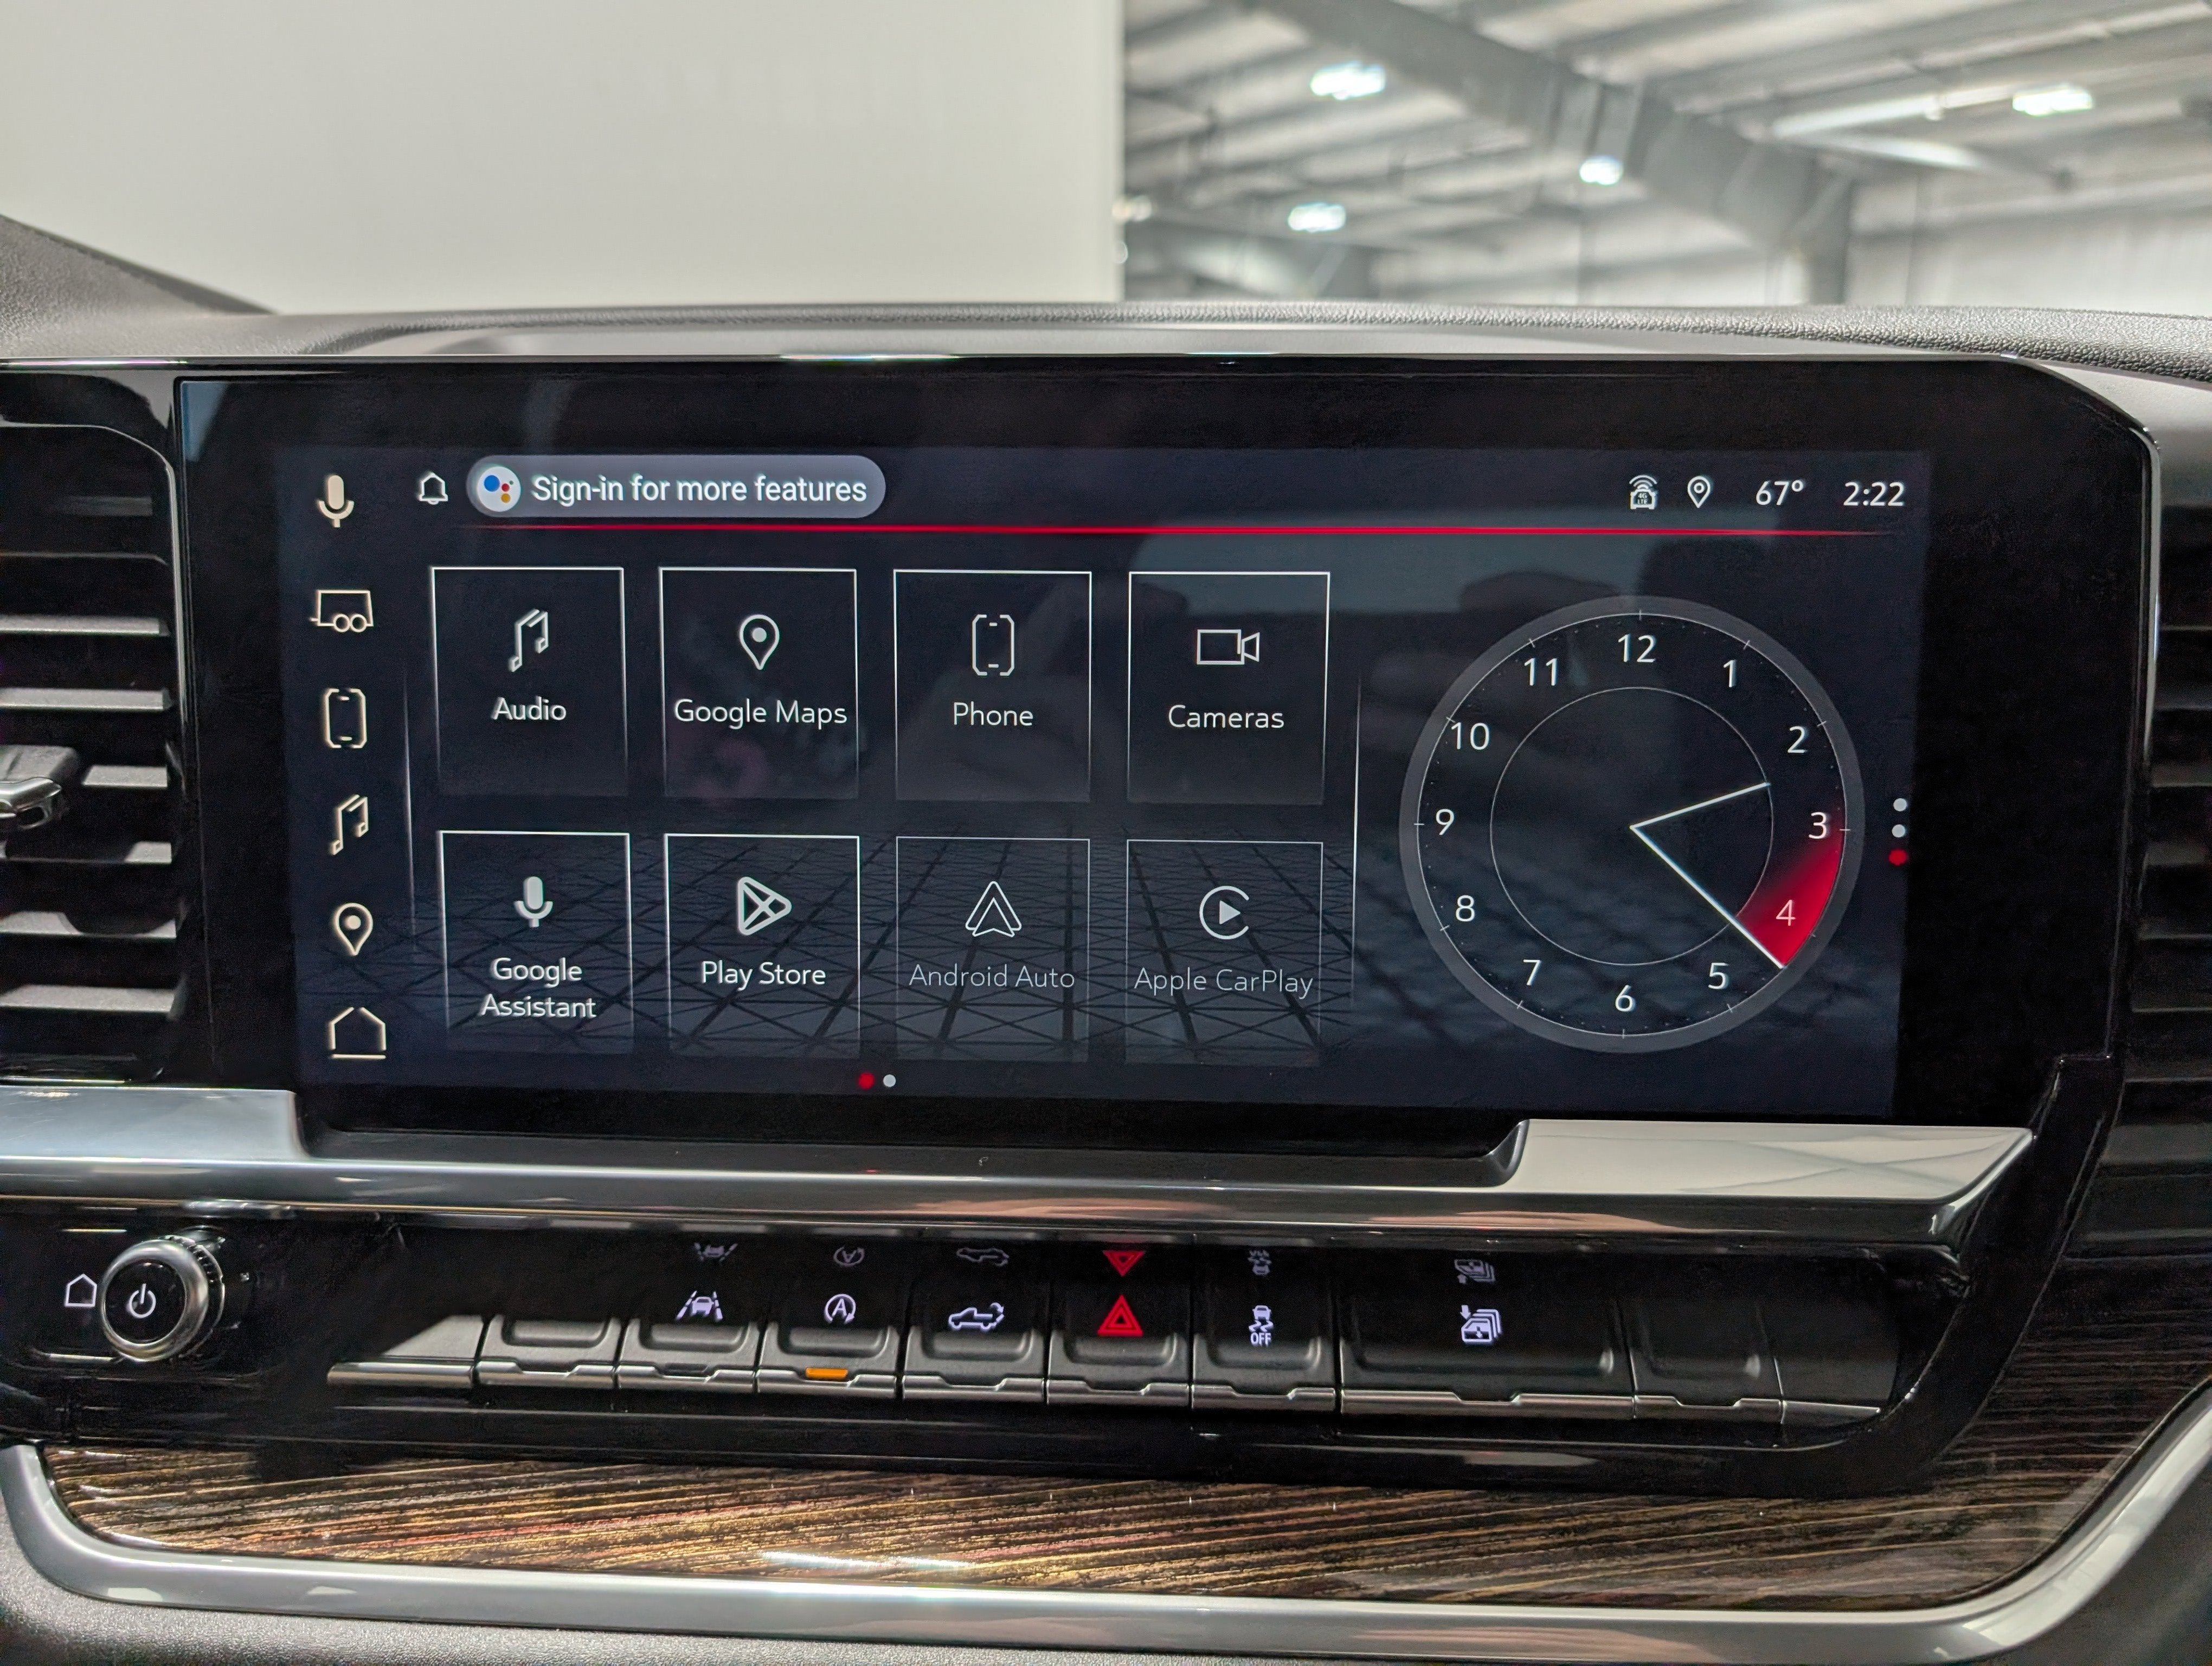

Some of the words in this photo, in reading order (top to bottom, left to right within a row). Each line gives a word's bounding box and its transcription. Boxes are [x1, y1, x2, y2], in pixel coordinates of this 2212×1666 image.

[532, 476, 623, 507] Sign-in
[631, 474, 670, 501] for
[677, 481, 747, 501] more
[754, 475, 866, 501] features
[1844, 482, 1904, 506] 2:22
[1618, 634, 1655, 662] 12
[1525, 658, 1557, 685] 11
[1724, 660, 1735, 687] 1
[492, 696, 566, 720] Audio
[674, 699, 767, 729] Google
[776, 700, 847, 730] Maps
[954, 701, 1033, 726] Phone
[1169, 705, 1284, 728] Cameras
[1451, 722, 1490, 751] 10
[1787, 726, 1807, 753] 2
[1436, 809, 1454, 835] 9
[1809, 812, 1828, 839] 3
[1456, 895, 1475, 921] 8
[1776, 900, 1795, 926] 4
[491, 957, 582, 988] Google
[702, 960, 753, 991] Play
[760, 962, 826, 984] Store
[909, 963, 1007, 986] Android
[1015, 965, 1074, 988] Auto
[1134, 967, 1206, 996] Apple
[1217, 969, 1313, 999] CarPlay
[1523, 959, 1541, 985] 7
[1708, 963, 1728, 989] 5
[481, 994, 596, 1017] Assistant
[1616, 985, 1635, 1011] 6
[832, 1298, 847, 1317] A
[1250, 1332, 1271, 1345] OFF
